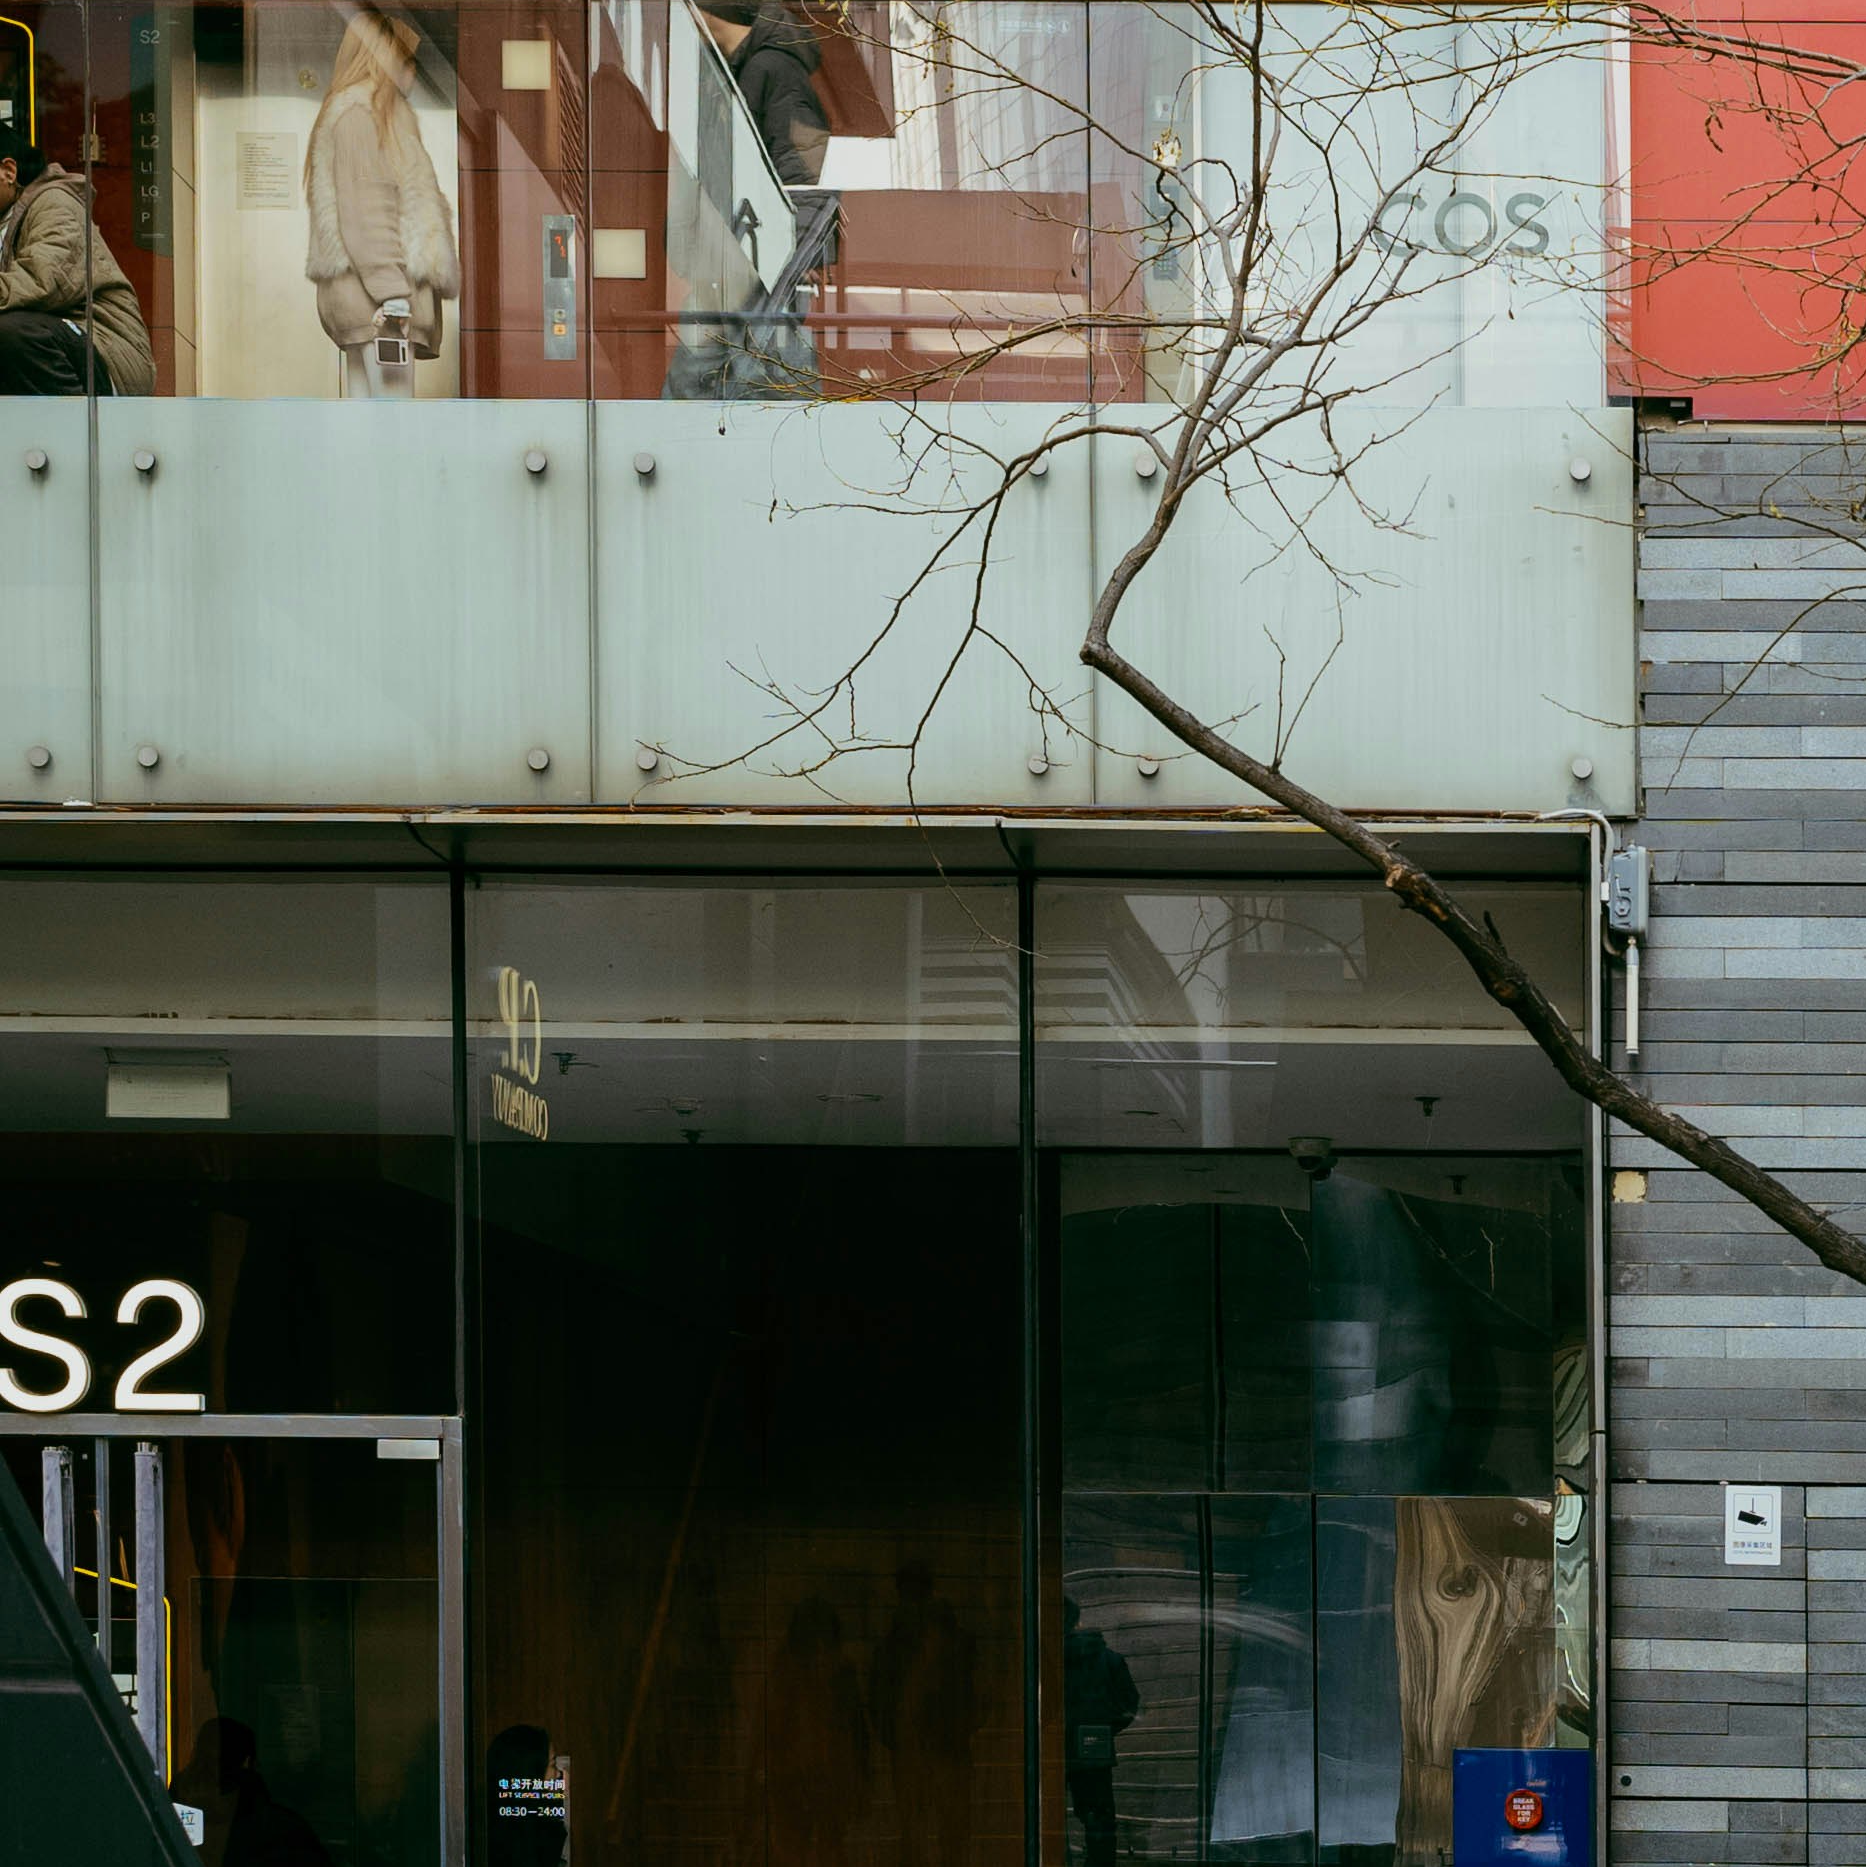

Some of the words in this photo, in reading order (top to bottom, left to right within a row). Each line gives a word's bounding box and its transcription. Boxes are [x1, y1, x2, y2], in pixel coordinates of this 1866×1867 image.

[139, 29, 161, 45] S2
[140, 112, 156, 125] L3
[140, 135, 161, 149] L2
[141, 185, 160, 198] LG
[141, 212, 151, 224] P
[1373, 192, 1550, 257] COS
[0, 1278, 206, 1413] S2
[499, 1778, 566, 1791] 电梯开放时间
